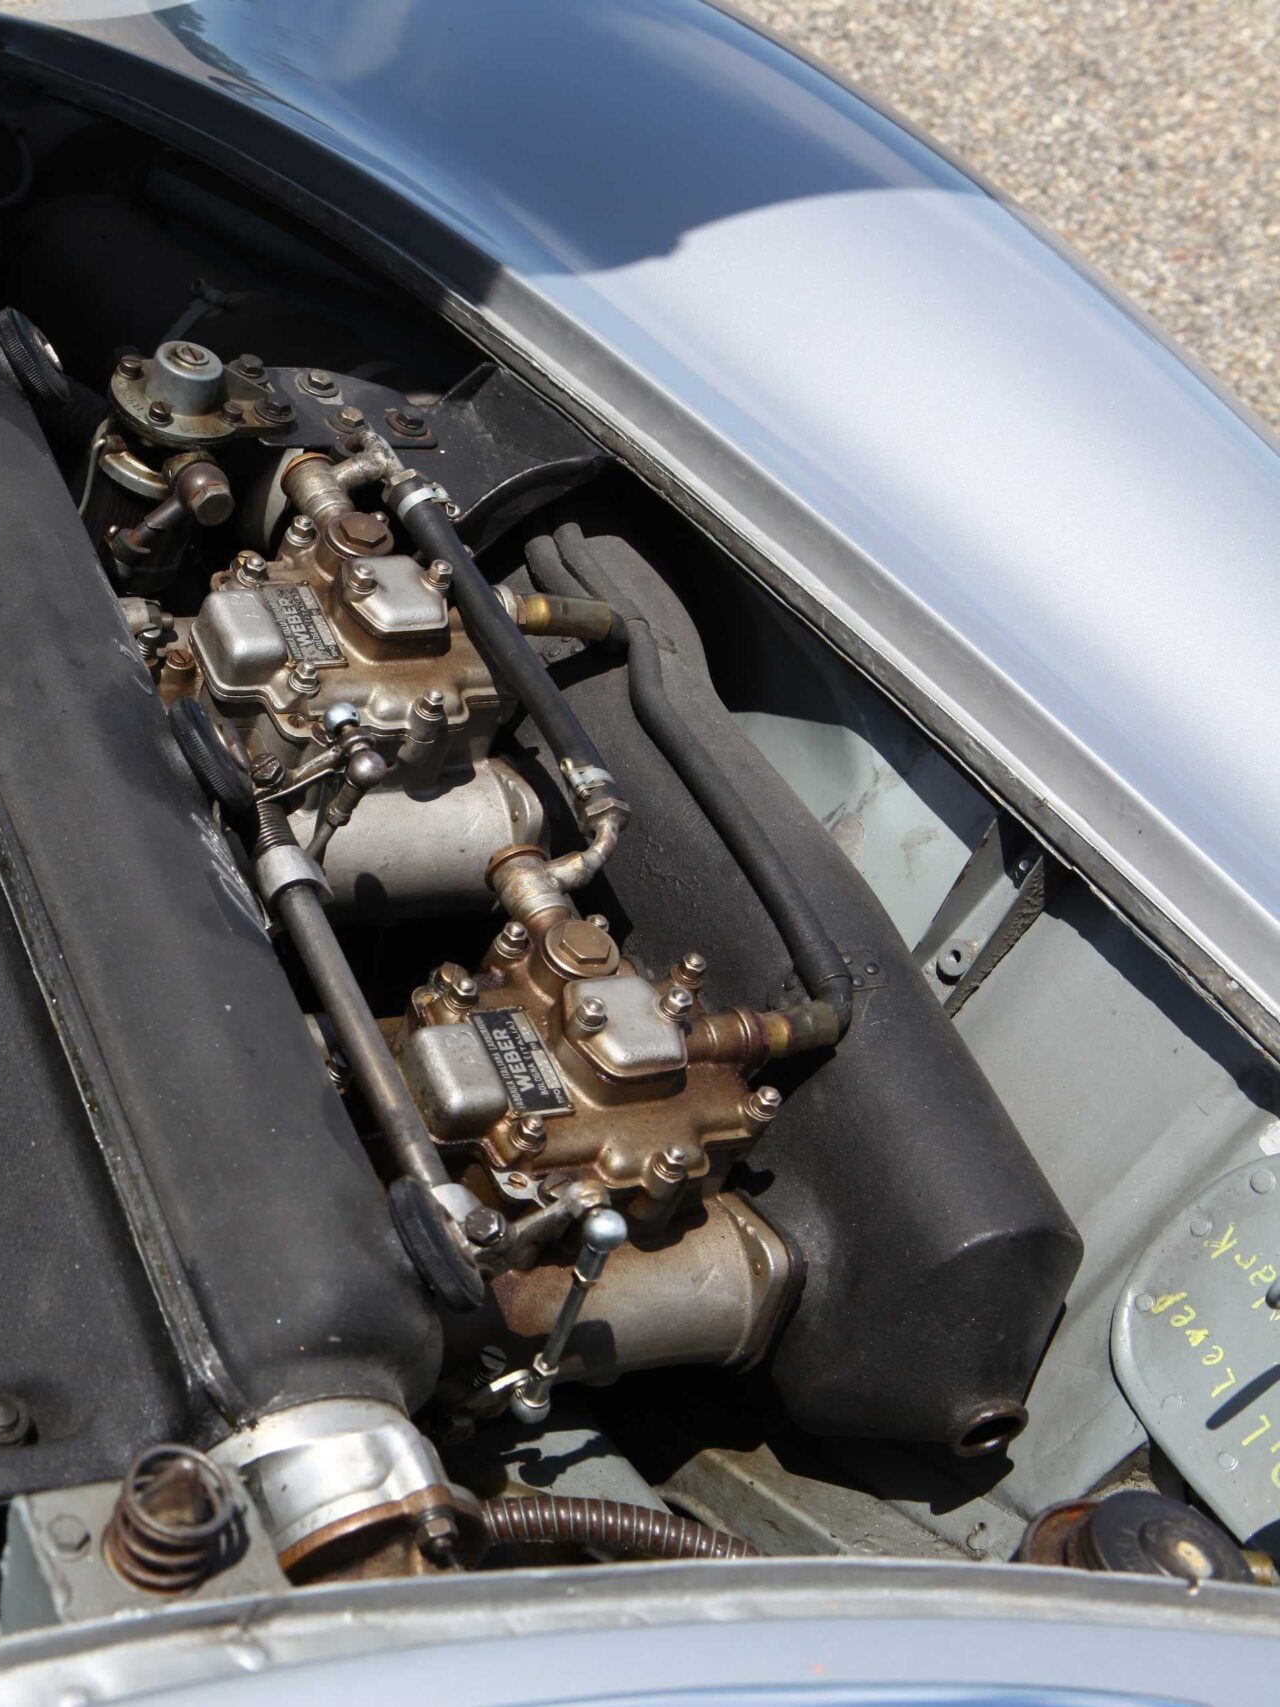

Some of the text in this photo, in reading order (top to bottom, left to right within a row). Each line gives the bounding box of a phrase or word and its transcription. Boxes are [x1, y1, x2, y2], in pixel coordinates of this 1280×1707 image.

[276, 597, 314, 646] WEBER
[504, 1020, 532, 1059] (ITALIA)
[490, 1028, 536, 1091] WEBER
[491, 1052, 511, 1078] ITALIANA
[526, 1062, 549, 1095] BOLOGNA
[552, 1088, 565, 1103] TIPO
